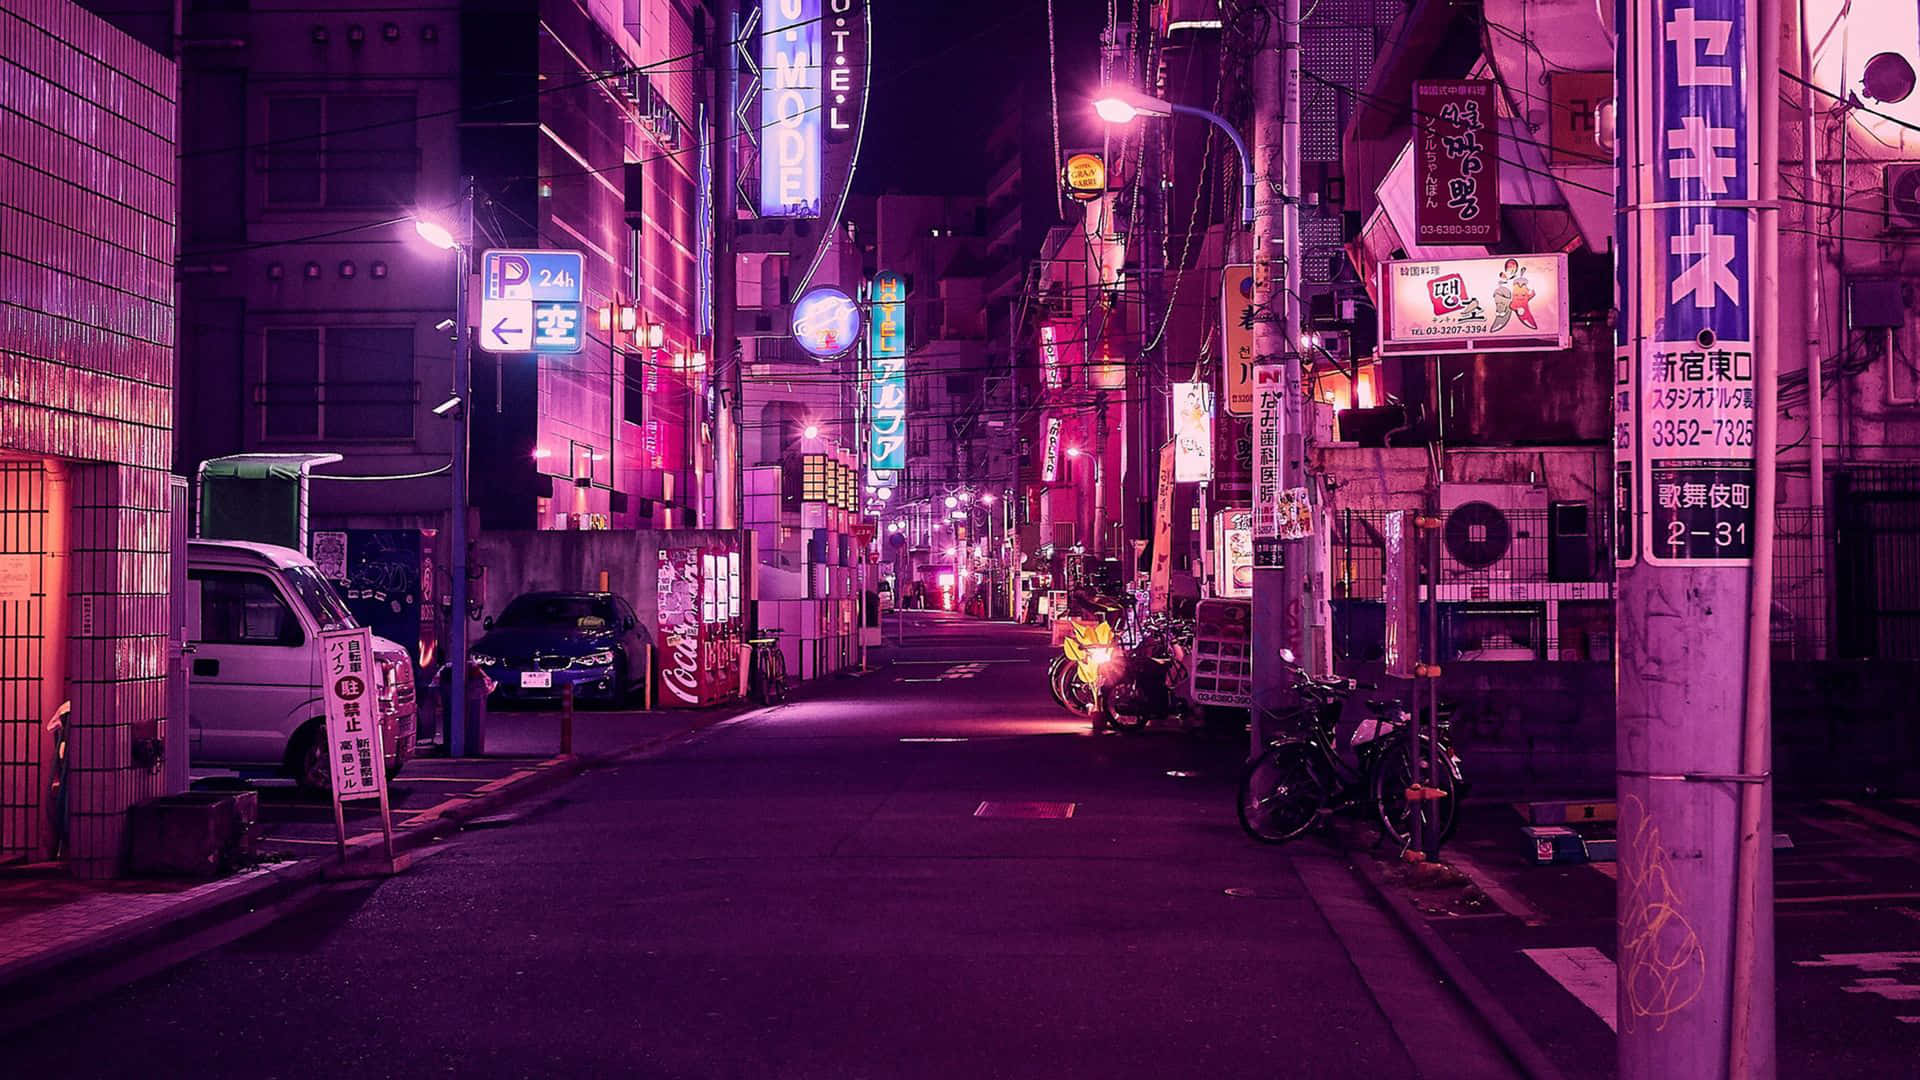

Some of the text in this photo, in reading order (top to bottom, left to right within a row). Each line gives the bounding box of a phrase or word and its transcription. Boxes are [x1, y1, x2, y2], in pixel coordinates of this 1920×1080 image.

[1666, 8, 1739, 307] セキネ
[1420, 225, 1490, 235] 03-6380-3907
[539, 268, 574, 288] 24h
[535, 304, 577, 345] 空
[880, 278, 896, 352] HOTEL
[1426, 325, 1487, 335] 03-3207-3394
[1652, 349, 1752, 383] 新宿東口
[1652, 388, 1753, 409] スタジオアルタ裏
[1652, 419, 1753, 447] 3352-7325
[1658, 482, 1750, 509] 歌舞伎町
[1667, 521, 1745, 546] 2-31
[331, 641, 344, 675] バイク
[348, 640, 362, 672] 自転車
[343, 702, 362, 733] 禁止
[340, 740, 357, 789] 高島ビル
